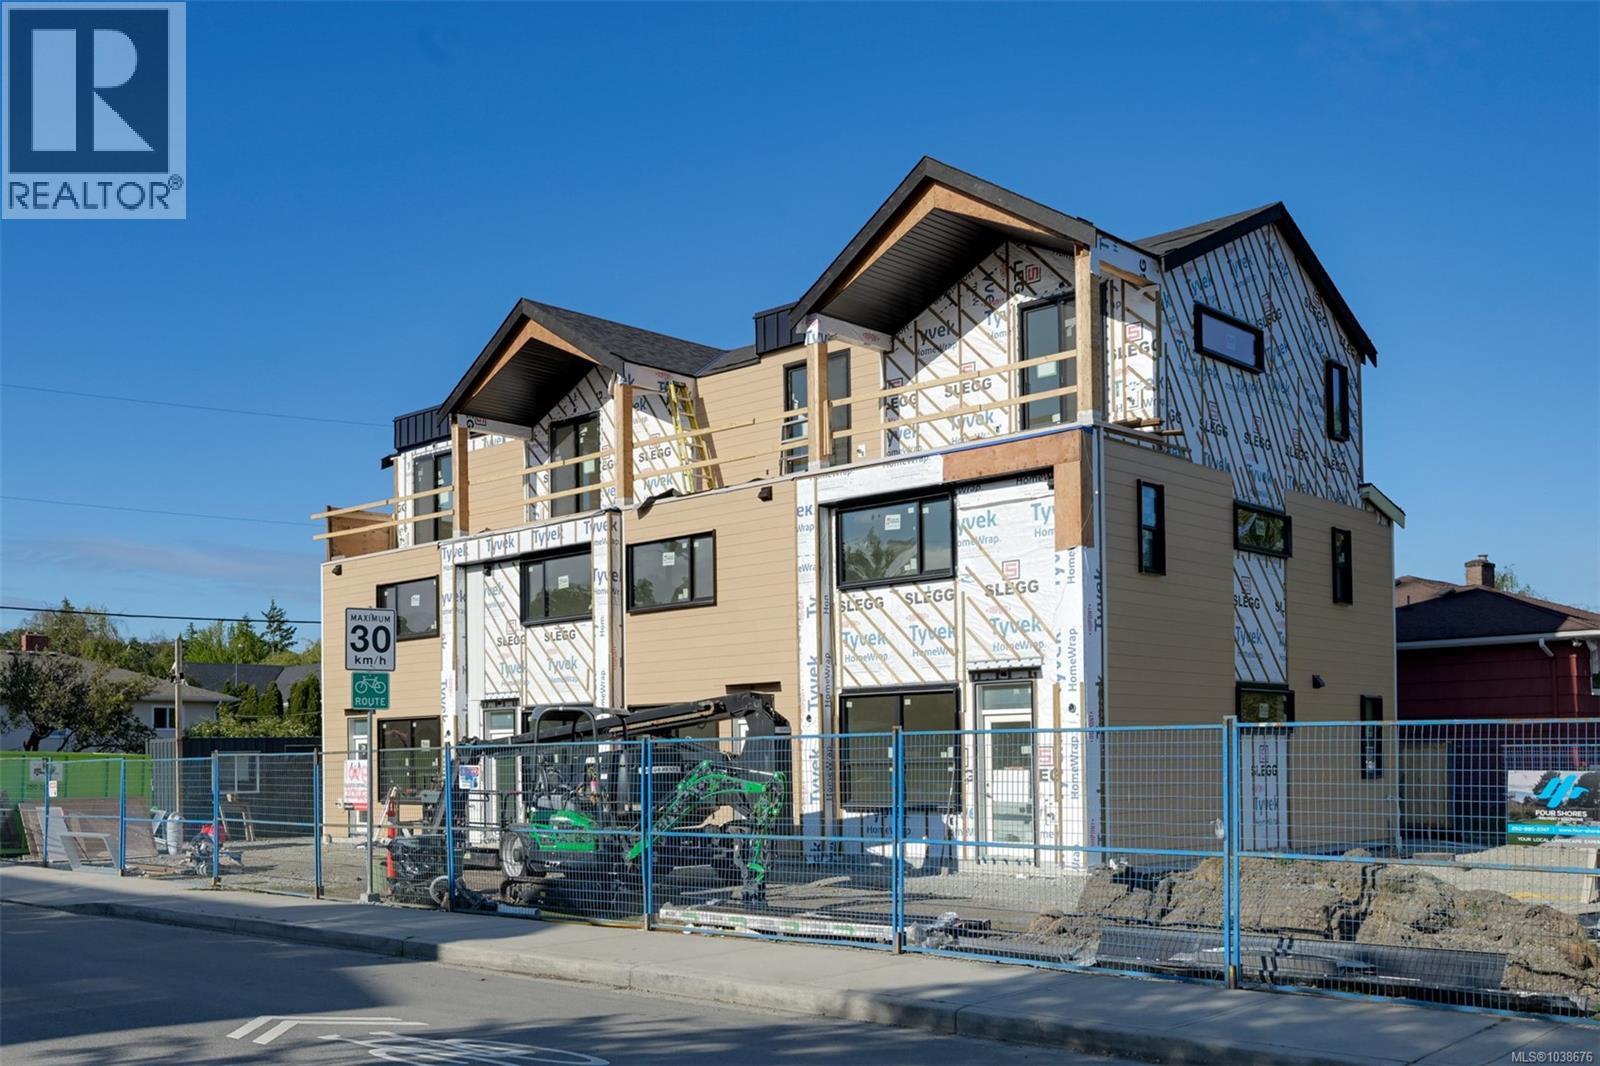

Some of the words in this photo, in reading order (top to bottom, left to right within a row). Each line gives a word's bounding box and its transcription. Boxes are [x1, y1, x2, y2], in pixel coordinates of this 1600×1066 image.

[920, 320, 956, 345] yvek
[1200, 418, 1228, 438] SLEGG
[1244, 431, 1271, 450] SLEGG
[957, 509, 997, 536] yvek
[486, 536, 515, 556] Tyvek
[905, 588, 954, 605] SLEGG
[985, 579, 1039, 598] SLEGG
[840, 596, 884, 612] SLEGG
[1233, 595, 1260, 610] SLEGG
[350, 614, 391, 623] MAXIMUM
[990, 616, 1041, 637] Tyvek
[350, 624, 391, 653] 30
[544, 629, 576, 642] SLEGG
[842, 631, 887, 650] Tyvek
[1235, 626, 1262, 647] Tyvek
[354, 655, 387, 665] km/h
[1067, 628, 1078, 692] HomeWrap
[355, 697, 386, 706] ROUTE
[1251, 764, 1278, 777] SLEGG
[1535, 809, 1556, 817] FOUR
[1556, 810, 1588, 818] SHORES
